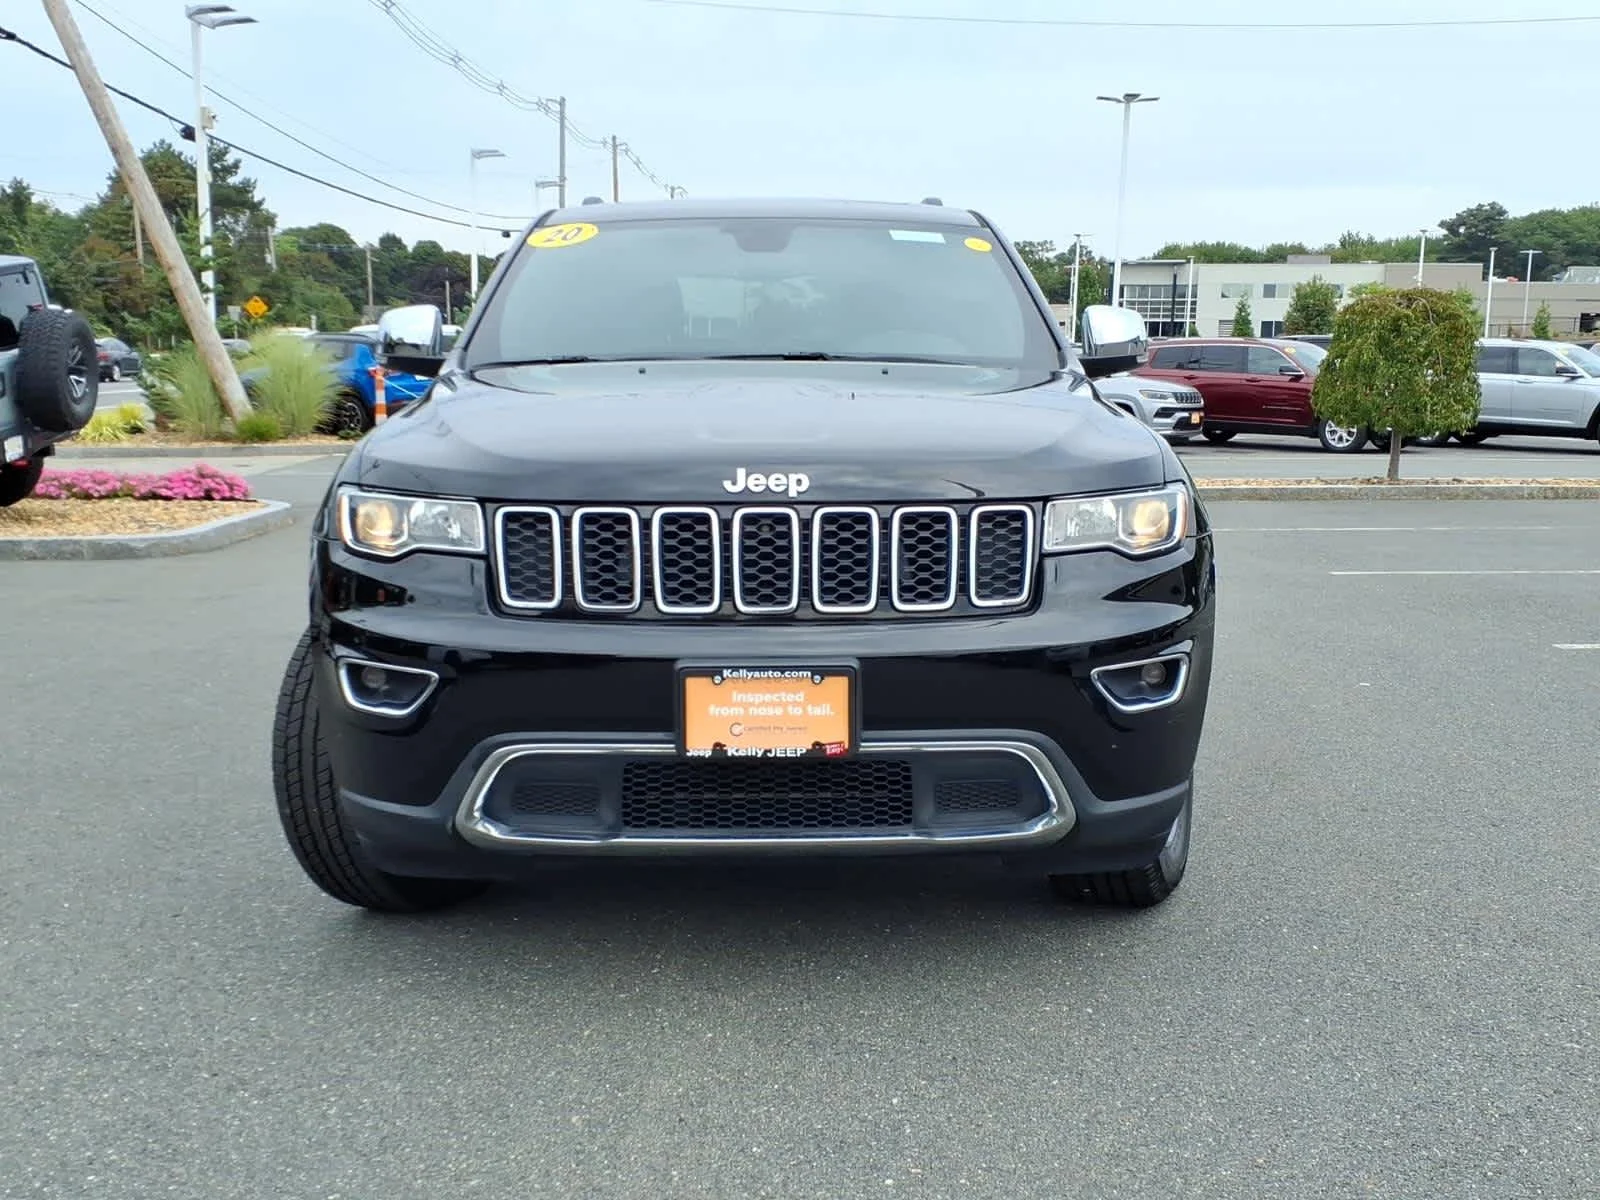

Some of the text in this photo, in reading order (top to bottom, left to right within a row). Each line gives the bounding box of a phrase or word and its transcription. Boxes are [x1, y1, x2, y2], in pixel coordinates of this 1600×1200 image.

[542, 226, 584, 243] 20
[722, 467, 810, 497] Jeep
[722, 669, 812, 679] Kellyauto.com
[731, 691, 805, 704] Inspected
[709, 703, 836, 716] from nose to tail.
[686, 747, 713, 758] Jeep
[727, 746, 807, 758] Kelly JEEP
